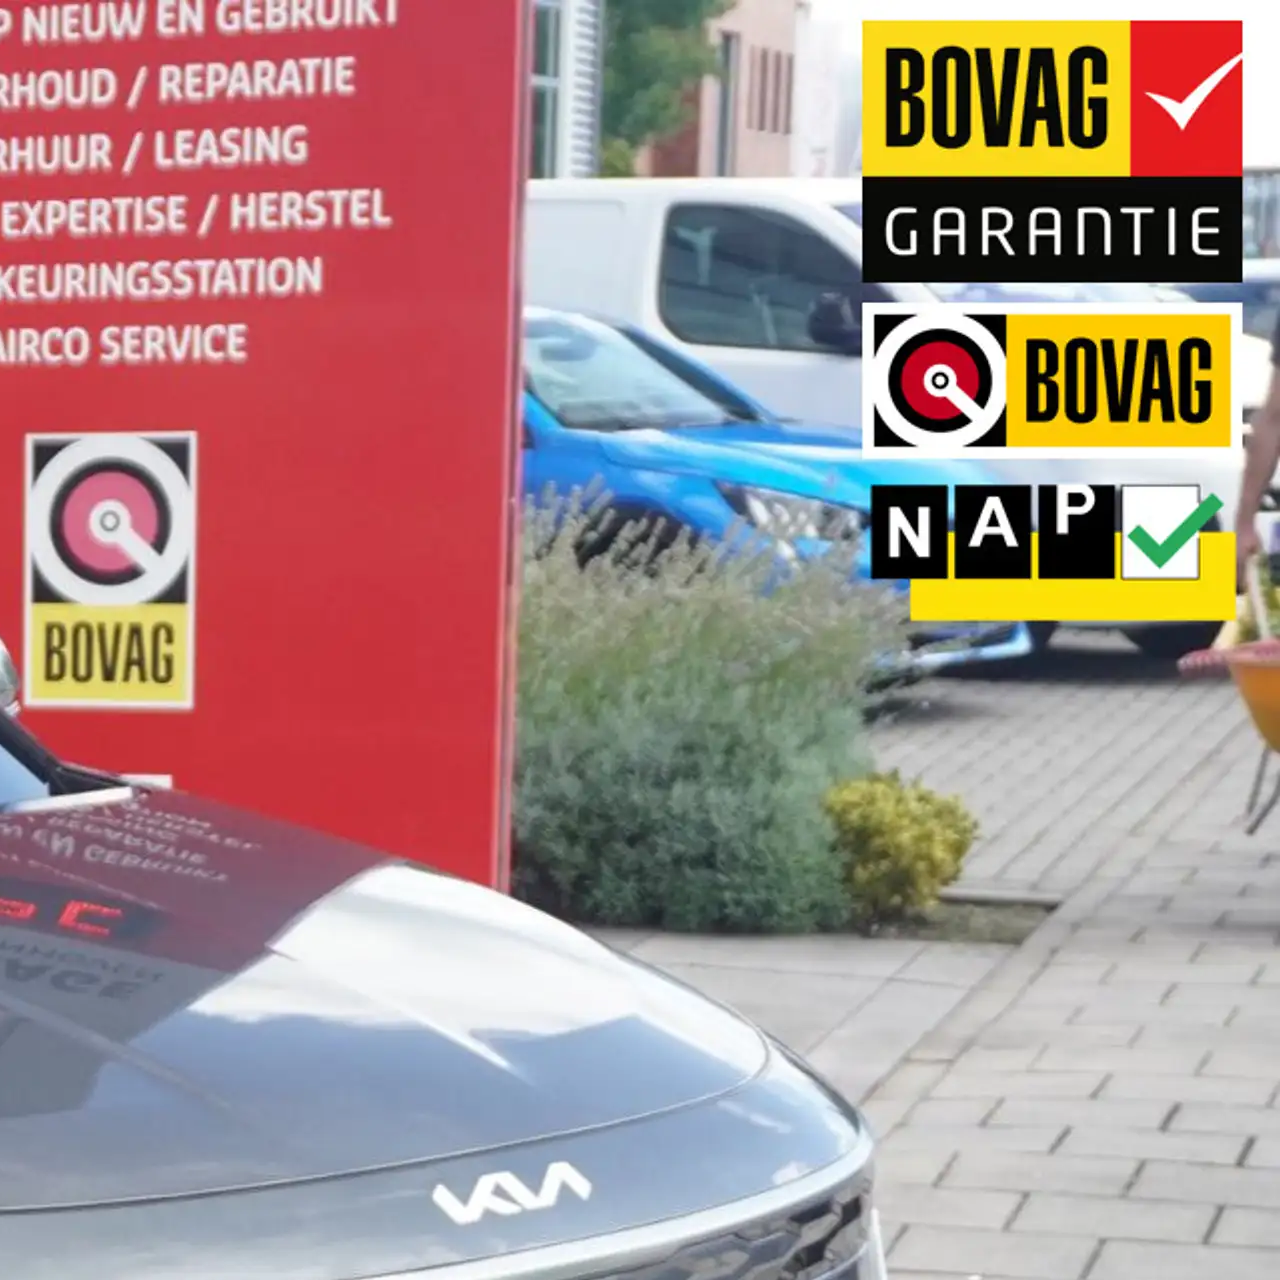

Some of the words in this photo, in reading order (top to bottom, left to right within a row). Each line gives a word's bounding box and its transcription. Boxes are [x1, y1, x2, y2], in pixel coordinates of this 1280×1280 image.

[22, 1, 144, 44] NIEUW
[156, 0, 204, 38] EN
[126, 66, 147, 110] /
[159, 56, 356, 102] REPARATIE
[122, 132, 143, 176] /
[154, 125, 309, 170] LEASING
[0, 196, 187, 240] EXPERTISE
[197, 193, 219, 238] /
[229, 188, 392, 232] HERSTEL
[99, 324, 248, 364] SERVICE
[44, 621, 175, 684] BOVAG
